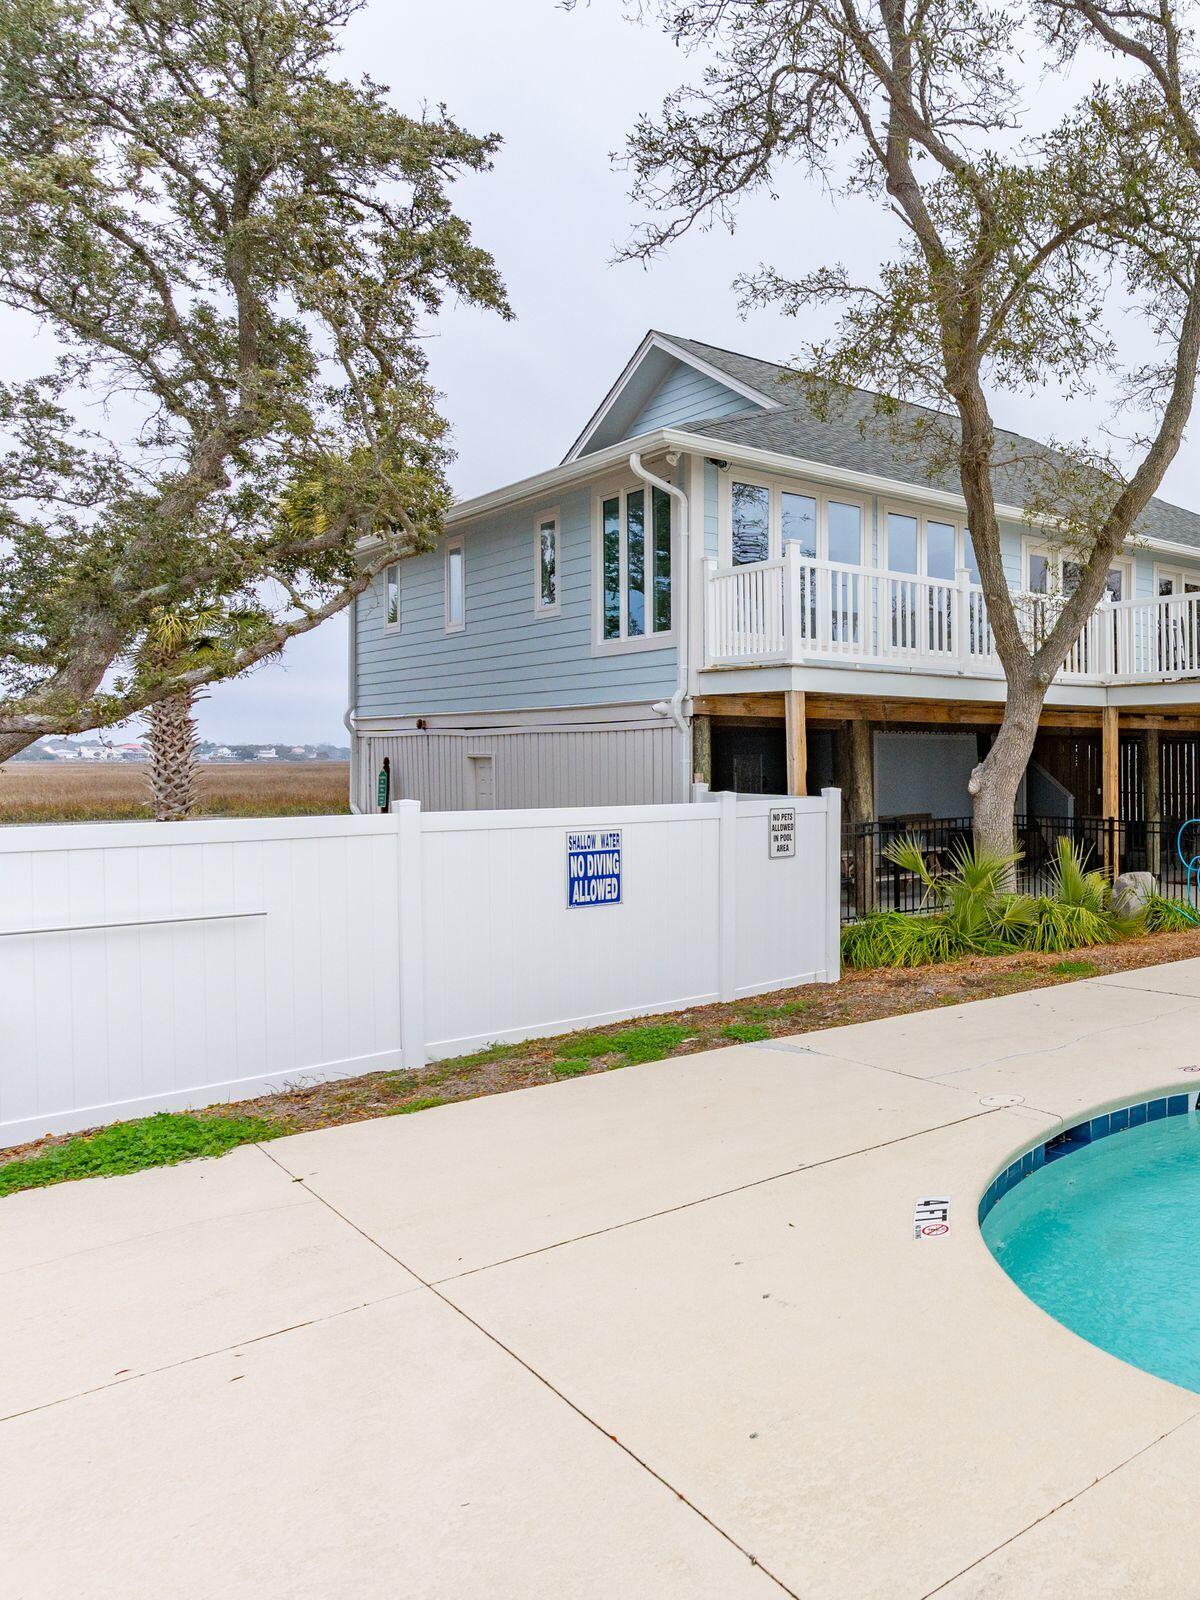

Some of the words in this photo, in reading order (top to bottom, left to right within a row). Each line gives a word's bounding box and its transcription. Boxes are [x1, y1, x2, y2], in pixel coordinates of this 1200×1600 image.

[773, 813, 780, 821] NO
[781, 813, 793, 821] PETS
[772, 823, 793, 831] ALLOWED
[568, 834, 596, 851] SHALLOW
[600, 833, 620, 849] WATER
[773, 834, 779, 842] IN
[780, 833, 792, 841] POOL
[777, 844, 789, 852] AREA
[570, 854, 585, 878] NO
[587, 852, 620, 877] DIVING
[572, 877, 619, 903] ALLOWED
[915, 1208, 948, 1222] FT
